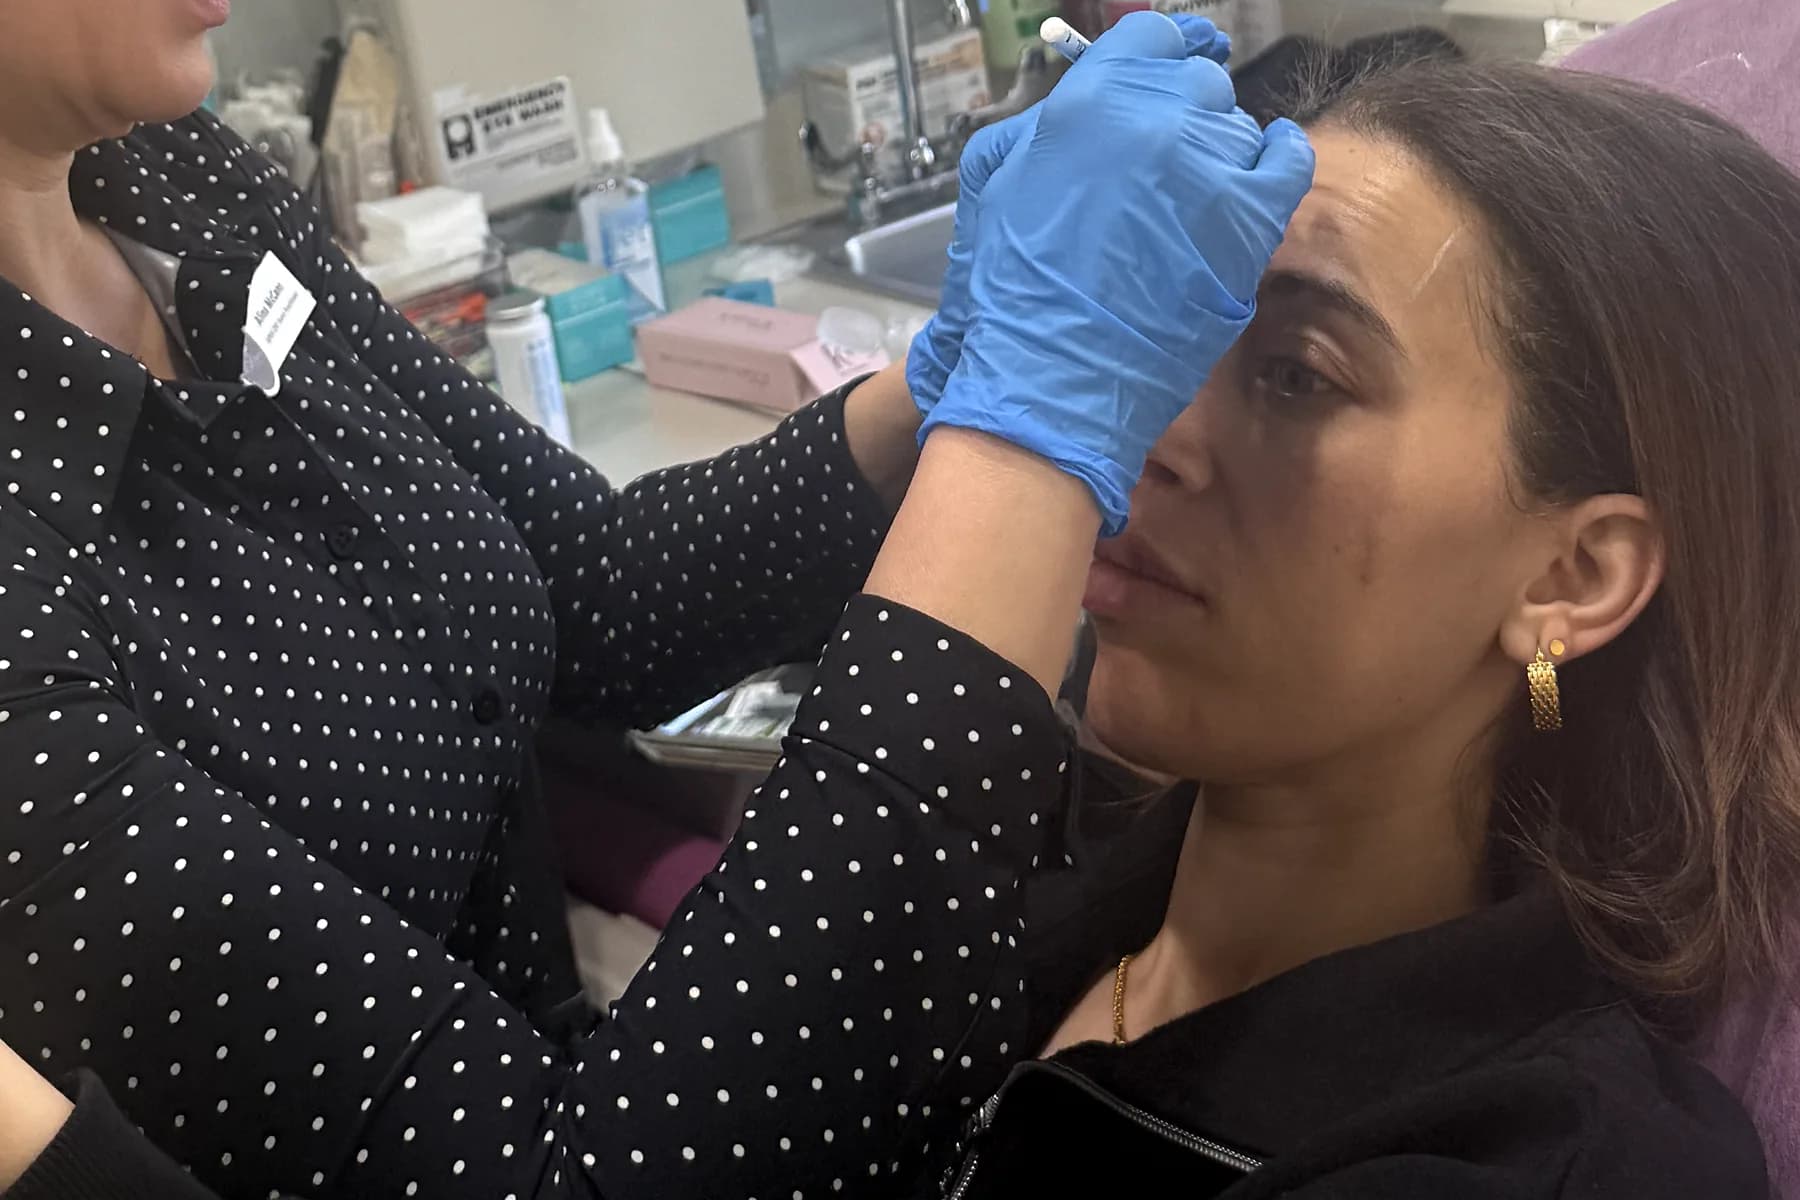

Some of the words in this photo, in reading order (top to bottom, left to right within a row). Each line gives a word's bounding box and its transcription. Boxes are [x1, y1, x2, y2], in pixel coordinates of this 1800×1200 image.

[474, 81, 565, 121] EMERGENCY
[482, 111, 513, 134] EYE
[518, 98, 564, 121] WASH
